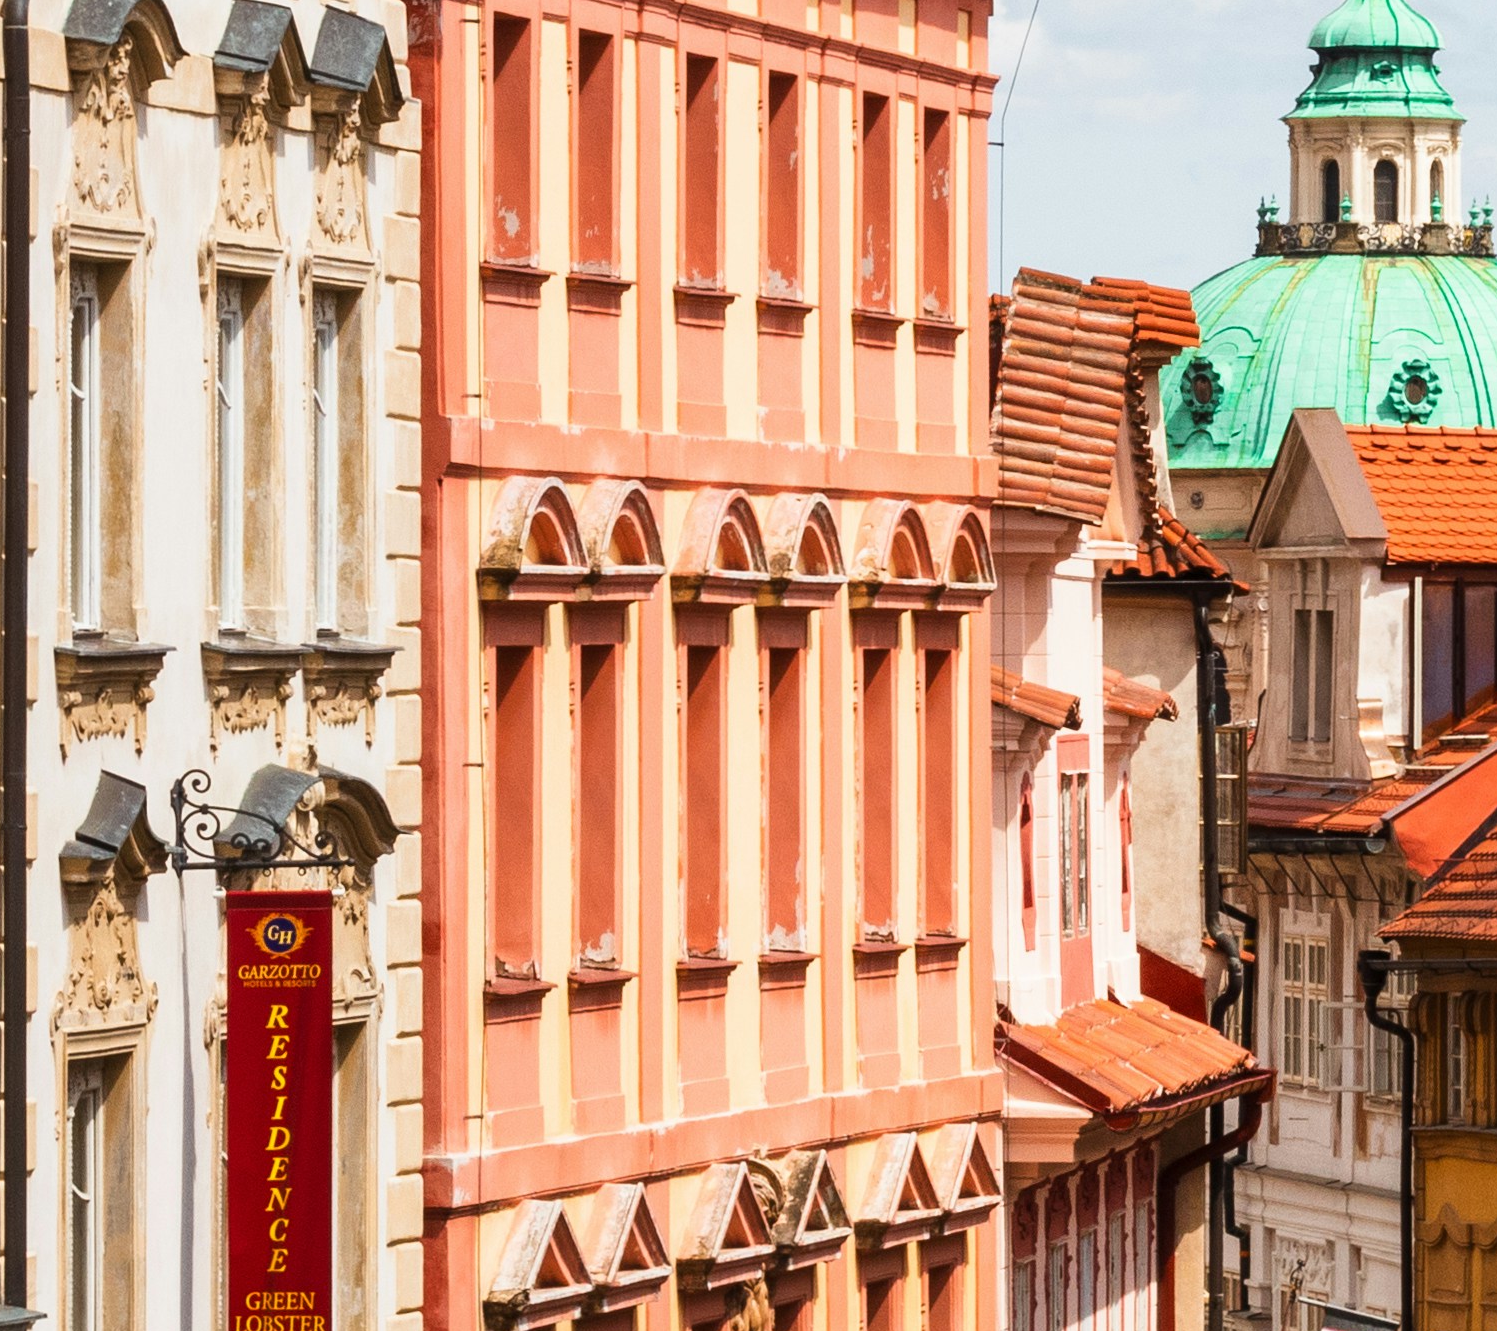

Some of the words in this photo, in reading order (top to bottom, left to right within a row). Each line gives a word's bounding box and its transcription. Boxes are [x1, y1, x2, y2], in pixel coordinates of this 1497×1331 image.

[238, 964, 322, 979] GARZOTTO
[243, 980, 273, 988] HOTELS
[283, 980, 317, 988] RESORTS
[266, 1004, 291, 1274] RESIDENCE
[245, 1291, 316, 1311] GREEN
